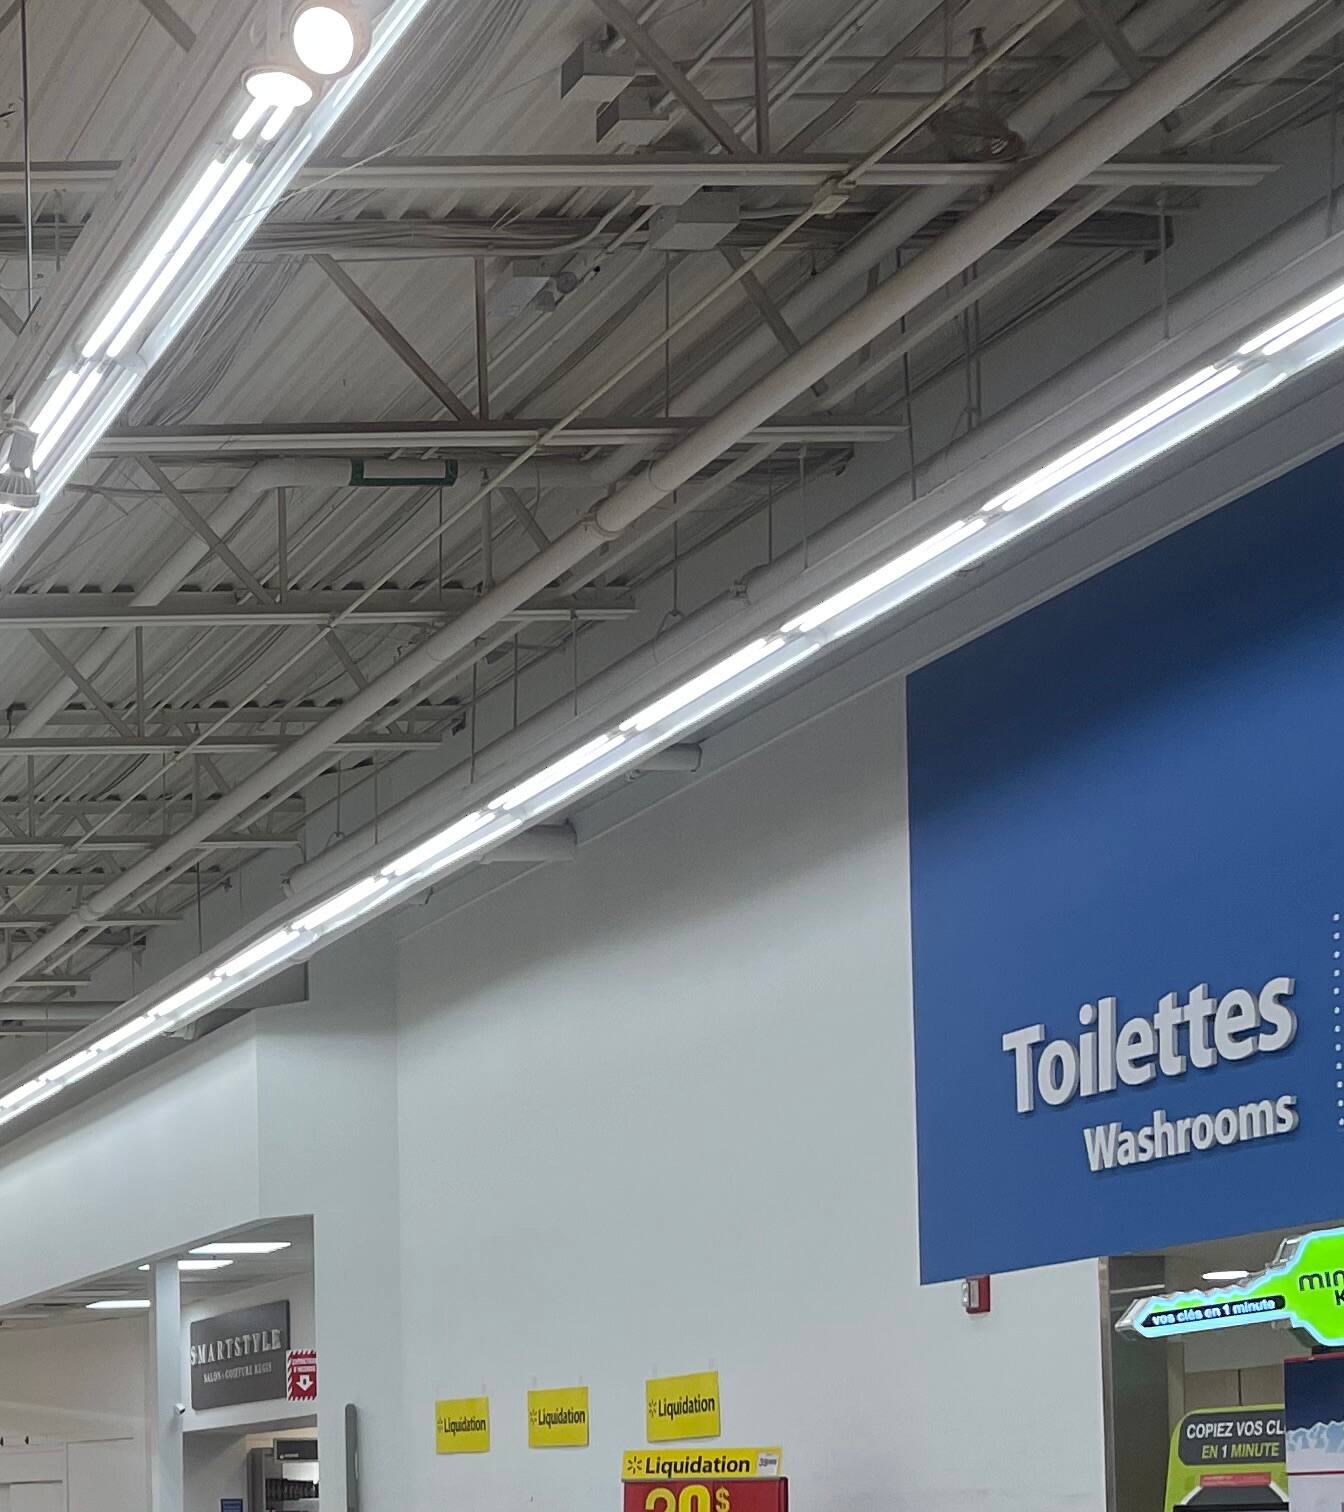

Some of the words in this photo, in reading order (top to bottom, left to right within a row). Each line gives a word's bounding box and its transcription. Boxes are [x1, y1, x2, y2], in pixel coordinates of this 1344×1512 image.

[1002, 977, 1298, 1114] Toilettes
[1083, 1094, 1299, 1172] Washrooms
[1152, 1314, 1175, 1325] vos
[1233, 1299, 1276, 1314] minute
[190, 1329, 281, 1366] SMARTSTYLE
[538, 1406, 586, 1430] Liquidation
[657, 1394, 715, 1419] Liquidation
[443, 1416, 486, 1434] Liquidation
[1186, 1422, 1233, 1439] COPIEZ
[1236, 1420, 1263, 1437] VOS
[1266, 1419, 1285, 1436] CL
[1201, 1444, 1219, 1459] EN
[1221, 1445, 1227, 1458] 1
[1231, 1442, 1280, 1458] MINUTE
[645, 1455, 751, 1479] Liquidation
